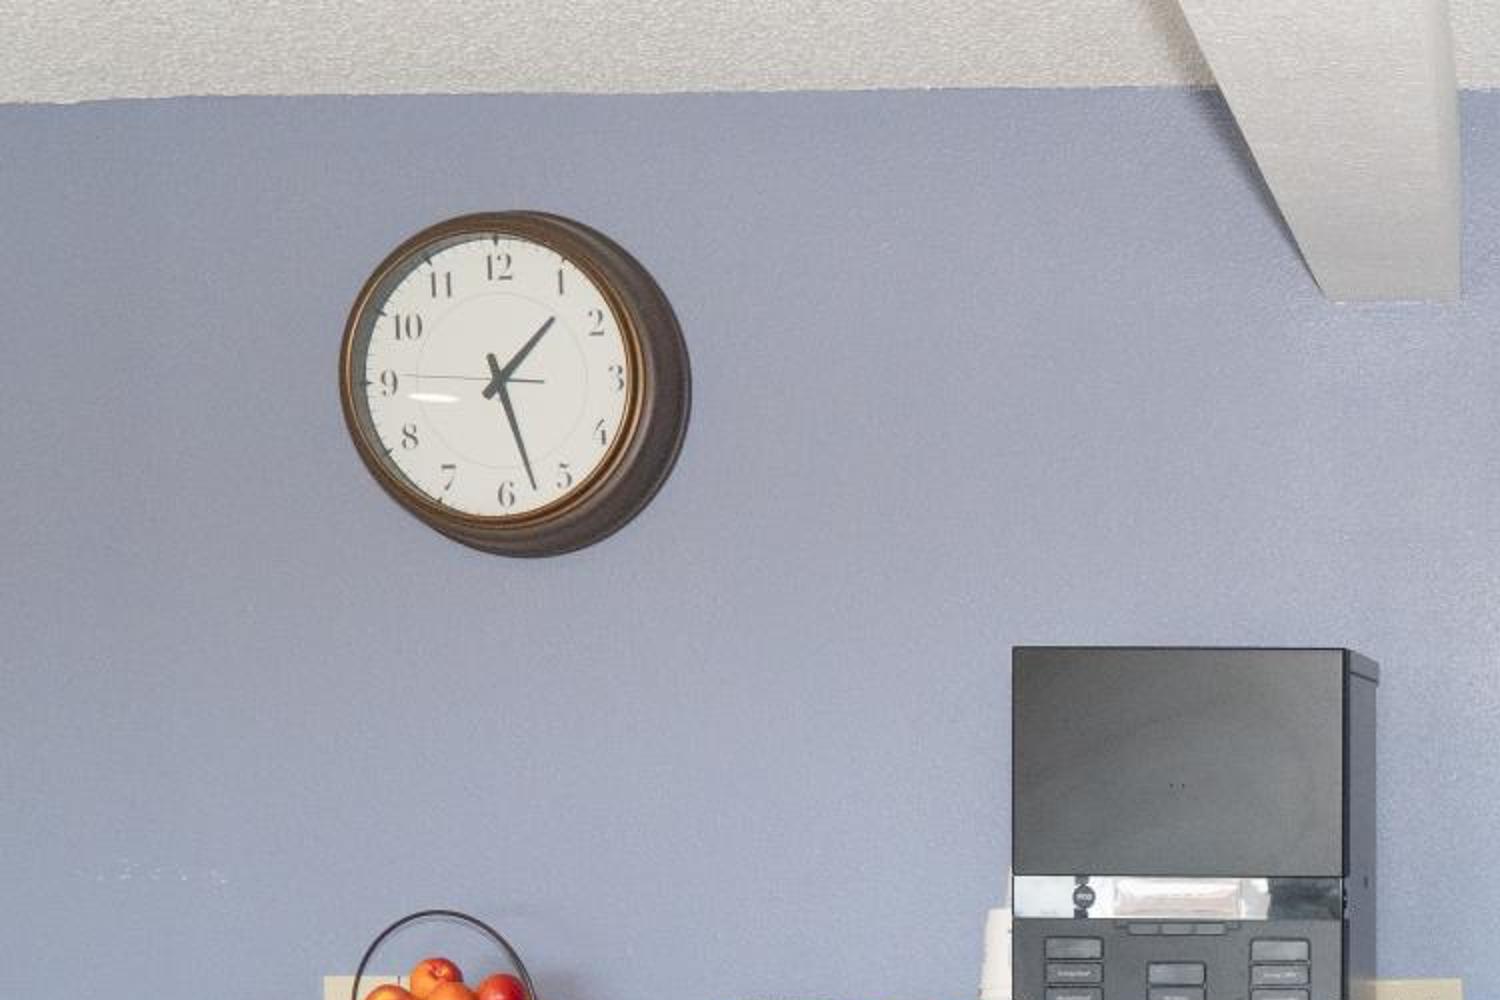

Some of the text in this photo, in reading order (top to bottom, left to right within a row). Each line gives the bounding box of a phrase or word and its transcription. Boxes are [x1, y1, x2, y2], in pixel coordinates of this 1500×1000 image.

[487, 253, 513, 280] 12
[431, 271, 452, 299] 11
[557, 268, 564, 295] 1
[392, 313, 423, 340] 10
[588, 309, 605, 336] 2
[380, 370, 398, 397] 9
[608, 365, 624, 391] 3
[402, 423, 419, 450] 8
[594, 419, 608, 446] 4
[441, 464, 457, 491] 7
[556, 464, 572, 490] 5
[497, 481, 515, 508] 6
